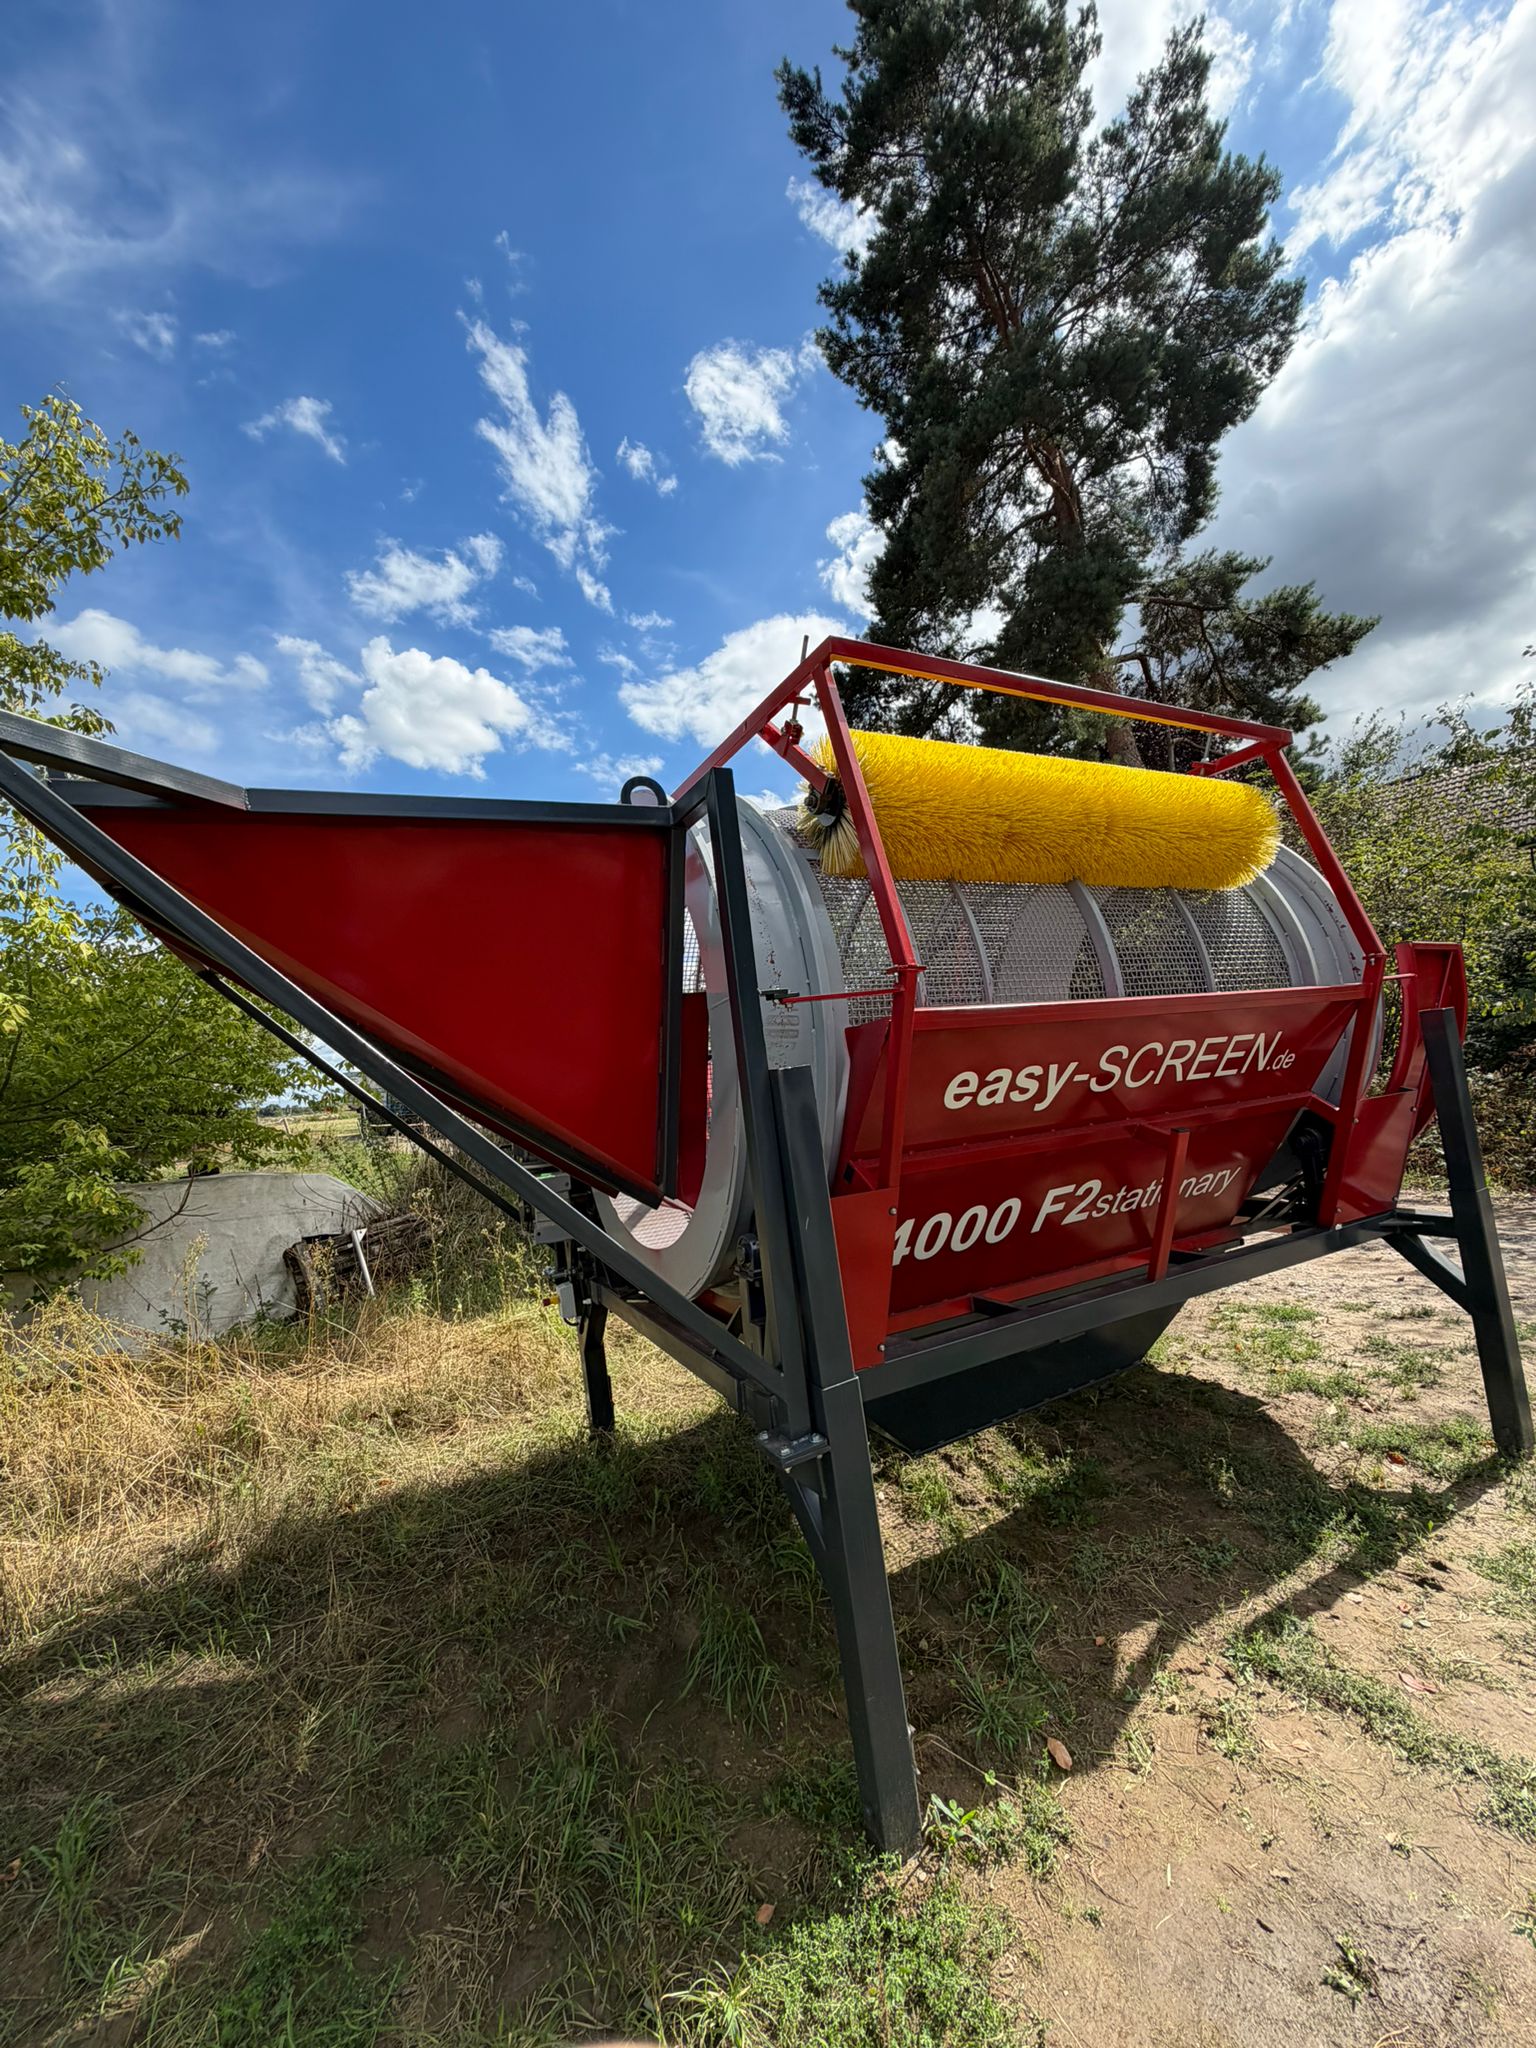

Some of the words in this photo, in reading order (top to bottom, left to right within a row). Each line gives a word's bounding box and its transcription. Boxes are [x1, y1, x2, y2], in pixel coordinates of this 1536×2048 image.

[943, 1031, 1295, 1112] easy-SCREEN.de
[892, 1197, 1022, 1267] 4000
[1030, 1167, 1242, 1234] F2statinary
